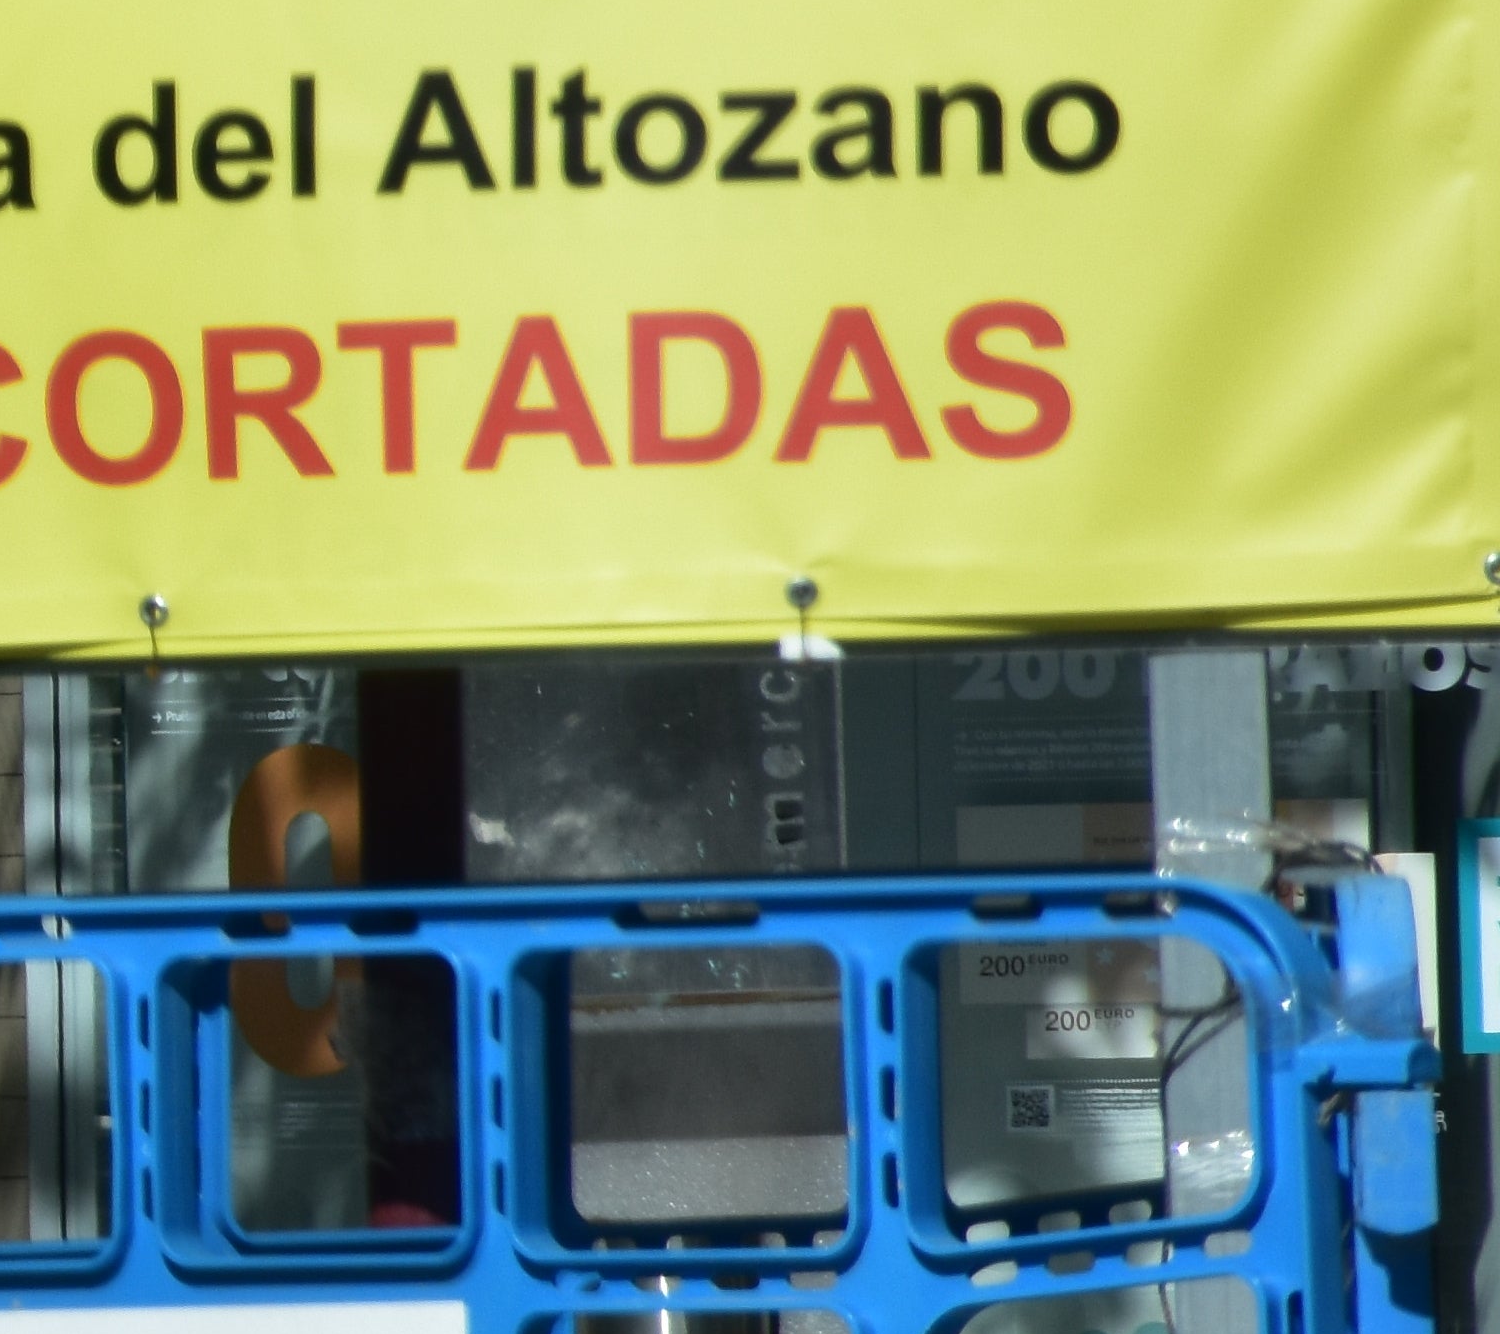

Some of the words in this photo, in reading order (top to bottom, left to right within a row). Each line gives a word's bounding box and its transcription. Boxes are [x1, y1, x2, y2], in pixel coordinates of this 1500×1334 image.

[93, 75, 318, 208] del
[376, 67, 1123, 194] Altozano
[978, 954, 1026, 978] 200
[1027, 952, 1070, 965] EURO
[1044, 1009, 1092, 1032] 200
[1093, 1007, 1135, 1020] EURO
